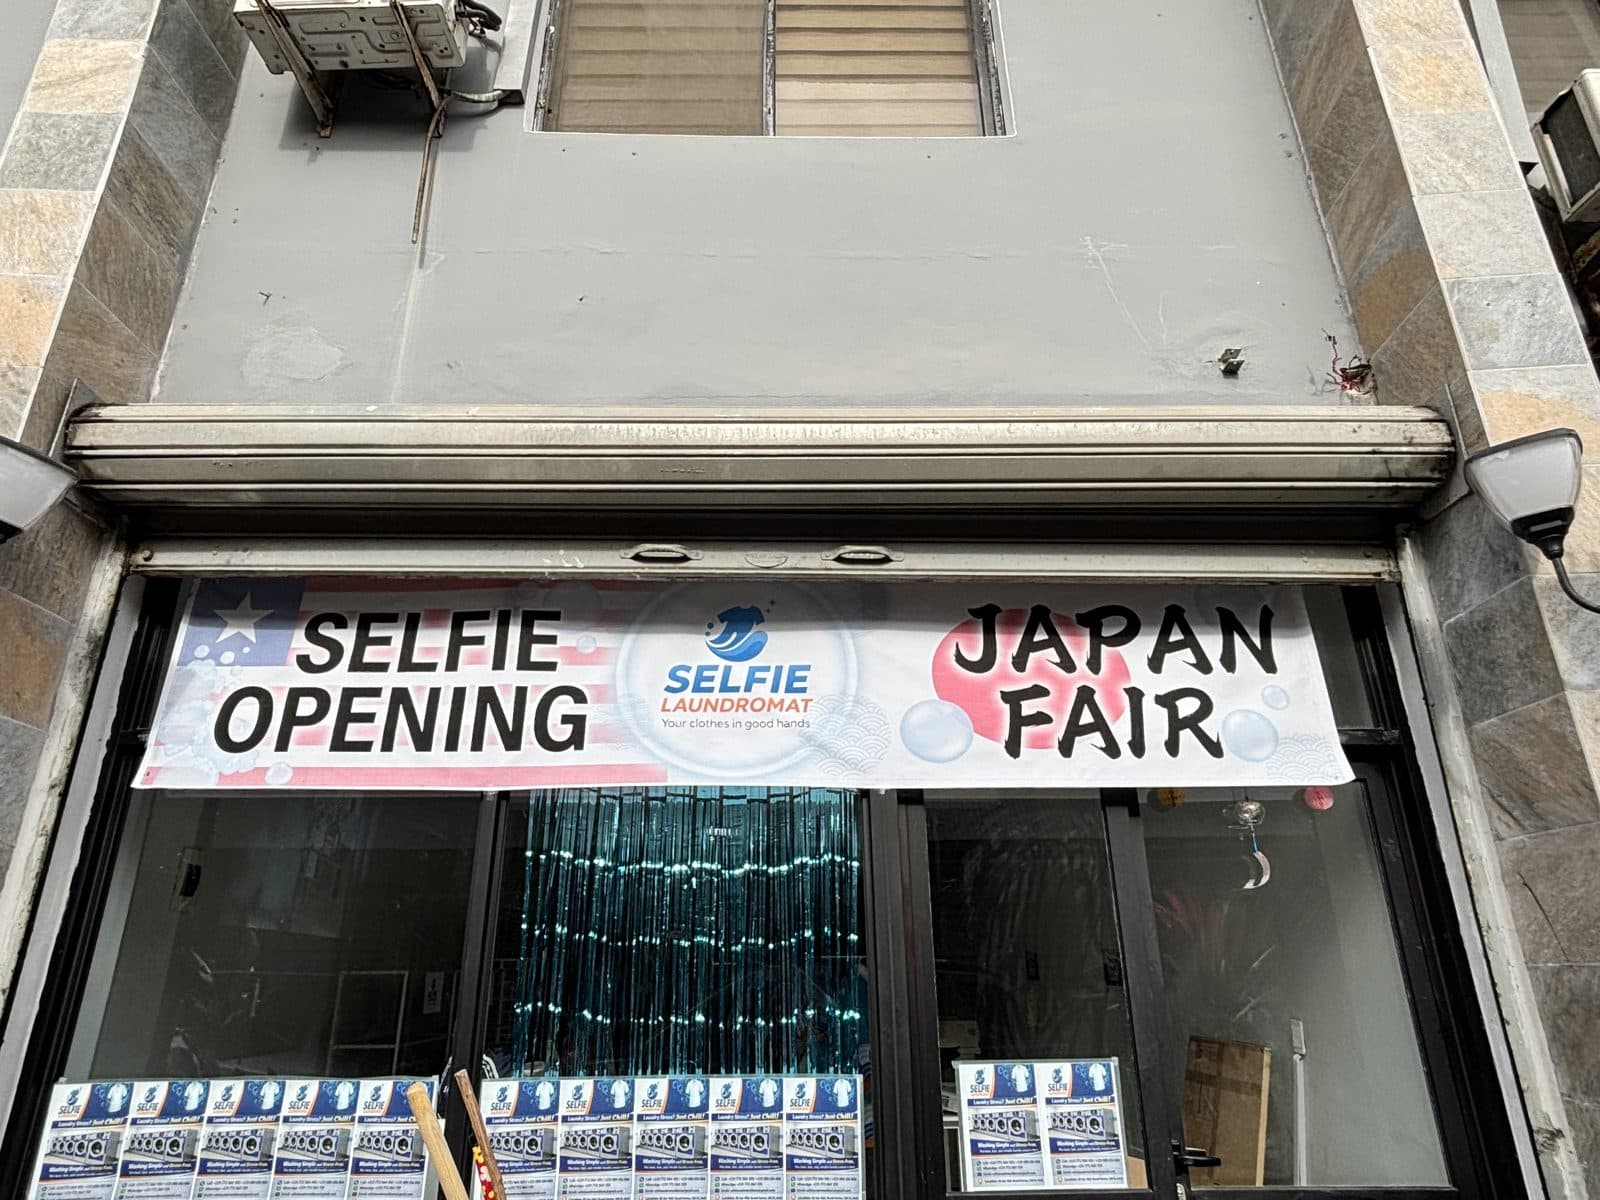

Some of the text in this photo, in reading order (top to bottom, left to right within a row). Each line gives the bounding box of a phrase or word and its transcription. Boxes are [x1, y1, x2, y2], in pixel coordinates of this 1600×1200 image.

[296, 609, 562, 674] SELFIE
[953, 603, 1278, 676] JAPAN
[664, 664, 811, 694] SELFIE
[660, 696, 813, 713] LAUNDROMAT
[213, 685, 590, 754] OPENING
[661, 718, 811, 730] Your clothes in good hands
[1000, 685, 1225, 760] FAIR
[970, 1085, 990, 1093] SELFIE
[1048, 1083, 1067, 1091] SELFIE
[137, 1103, 159, 1111] SELFIE
[214, 1101, 235, 1110] SELFIE
[288, 1101, 310, 1110] SELFIE
[363, 1101, 384, 1110] SELFIE
[490, 1102, 512, 1111] SELFIE
[566, 1100, 587, 1109] SELFIE
[642, 1099, 662, 1108] SELFIE
[716, 1099, 736, 1107] SELFIE
[790, 1099, 810, 1107] SELFIE
[58, 1105, 81, 1114] SELFIE
